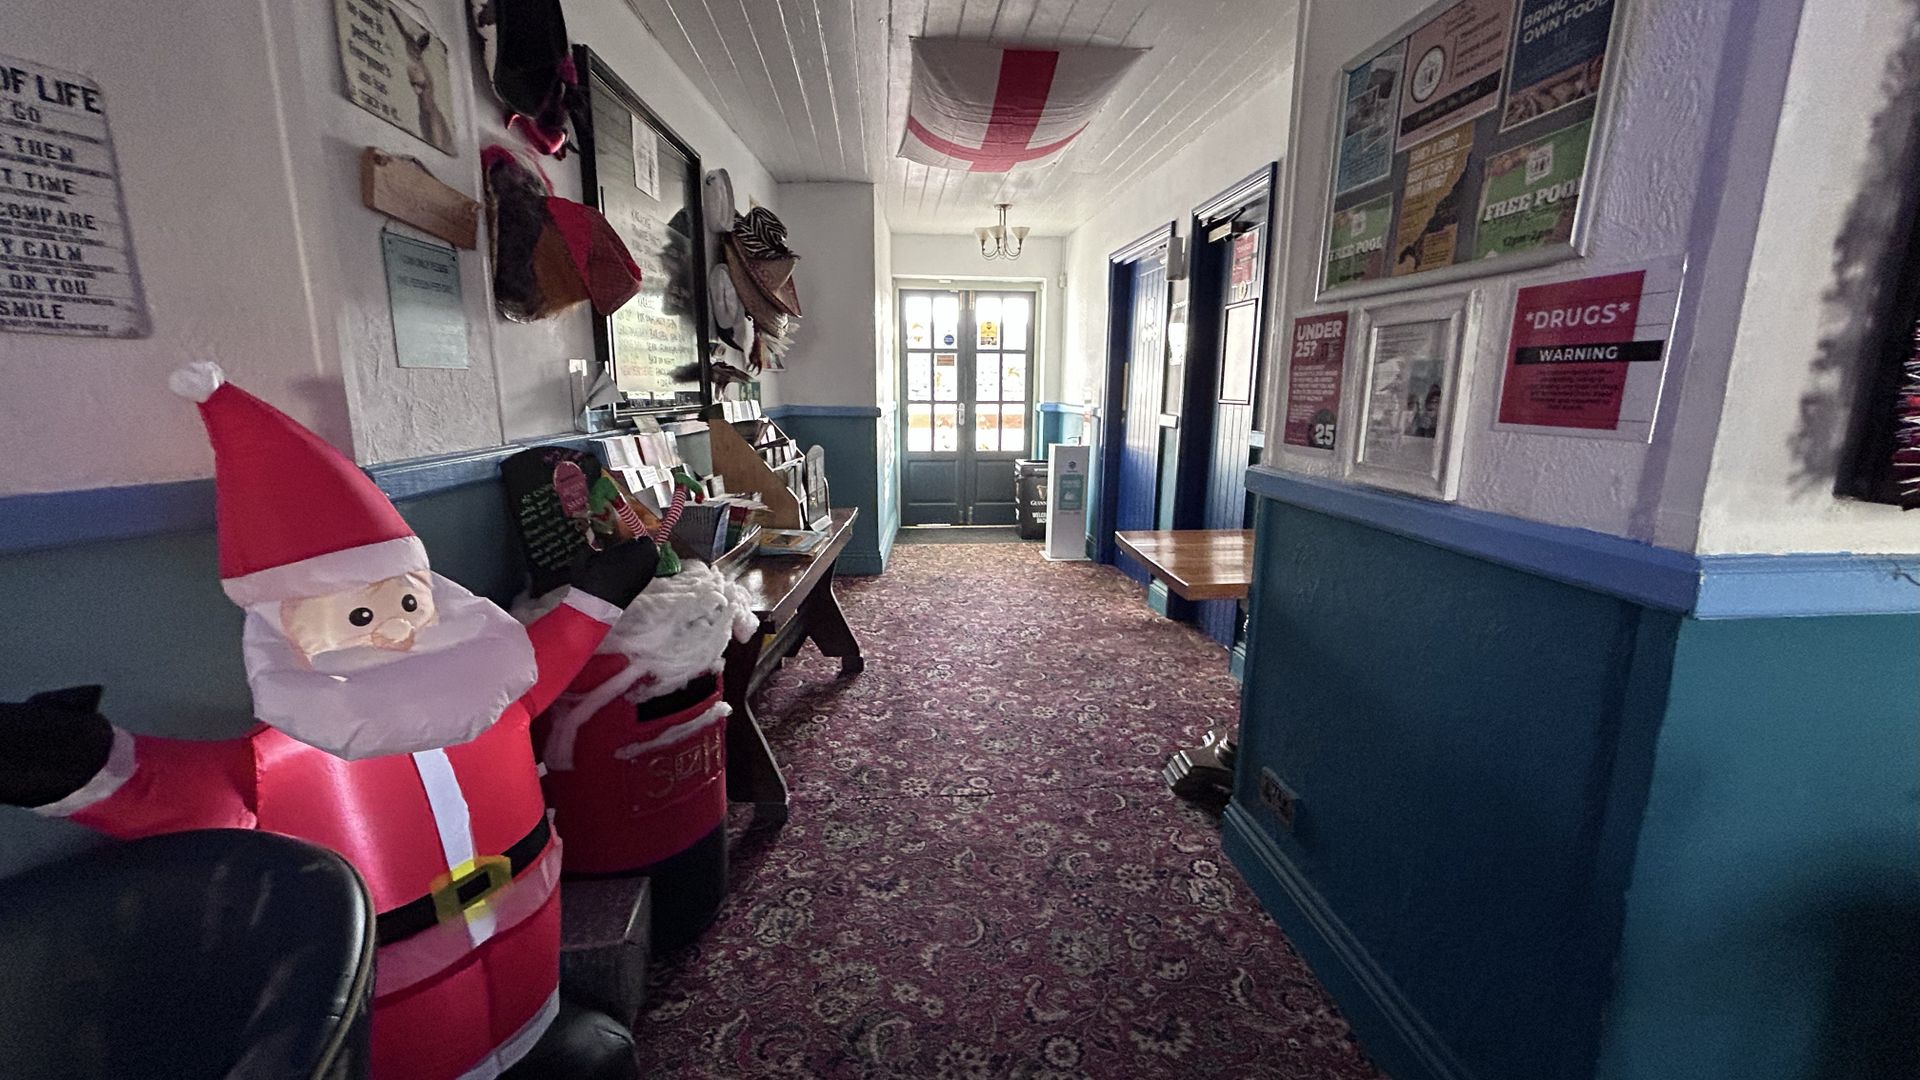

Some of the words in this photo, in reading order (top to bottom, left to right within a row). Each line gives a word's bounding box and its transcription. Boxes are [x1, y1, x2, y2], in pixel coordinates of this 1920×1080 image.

[1524, 15, 1560, 44] OWN
[36, 74, 104, 114] LIFE
[12, 101, 41, 123] GO
[23, 171, 77, 195] TIME
[1484, 193, 1532, 222] FREE
[1535, 176, 1583, 208] POO
[23, 241, 82, 262] CALM
[9, 274, 37, 290] ON
[45, 277, 87, 296] YOU
[0, 301, 65, 320] SMILE
[1297, 320, 1343, 341] UNDER
[1295, 341, 1318, 358] 25?
[1538, 346, 1619, 363] WARNING
[1315, 423, 1335, 446] 25
